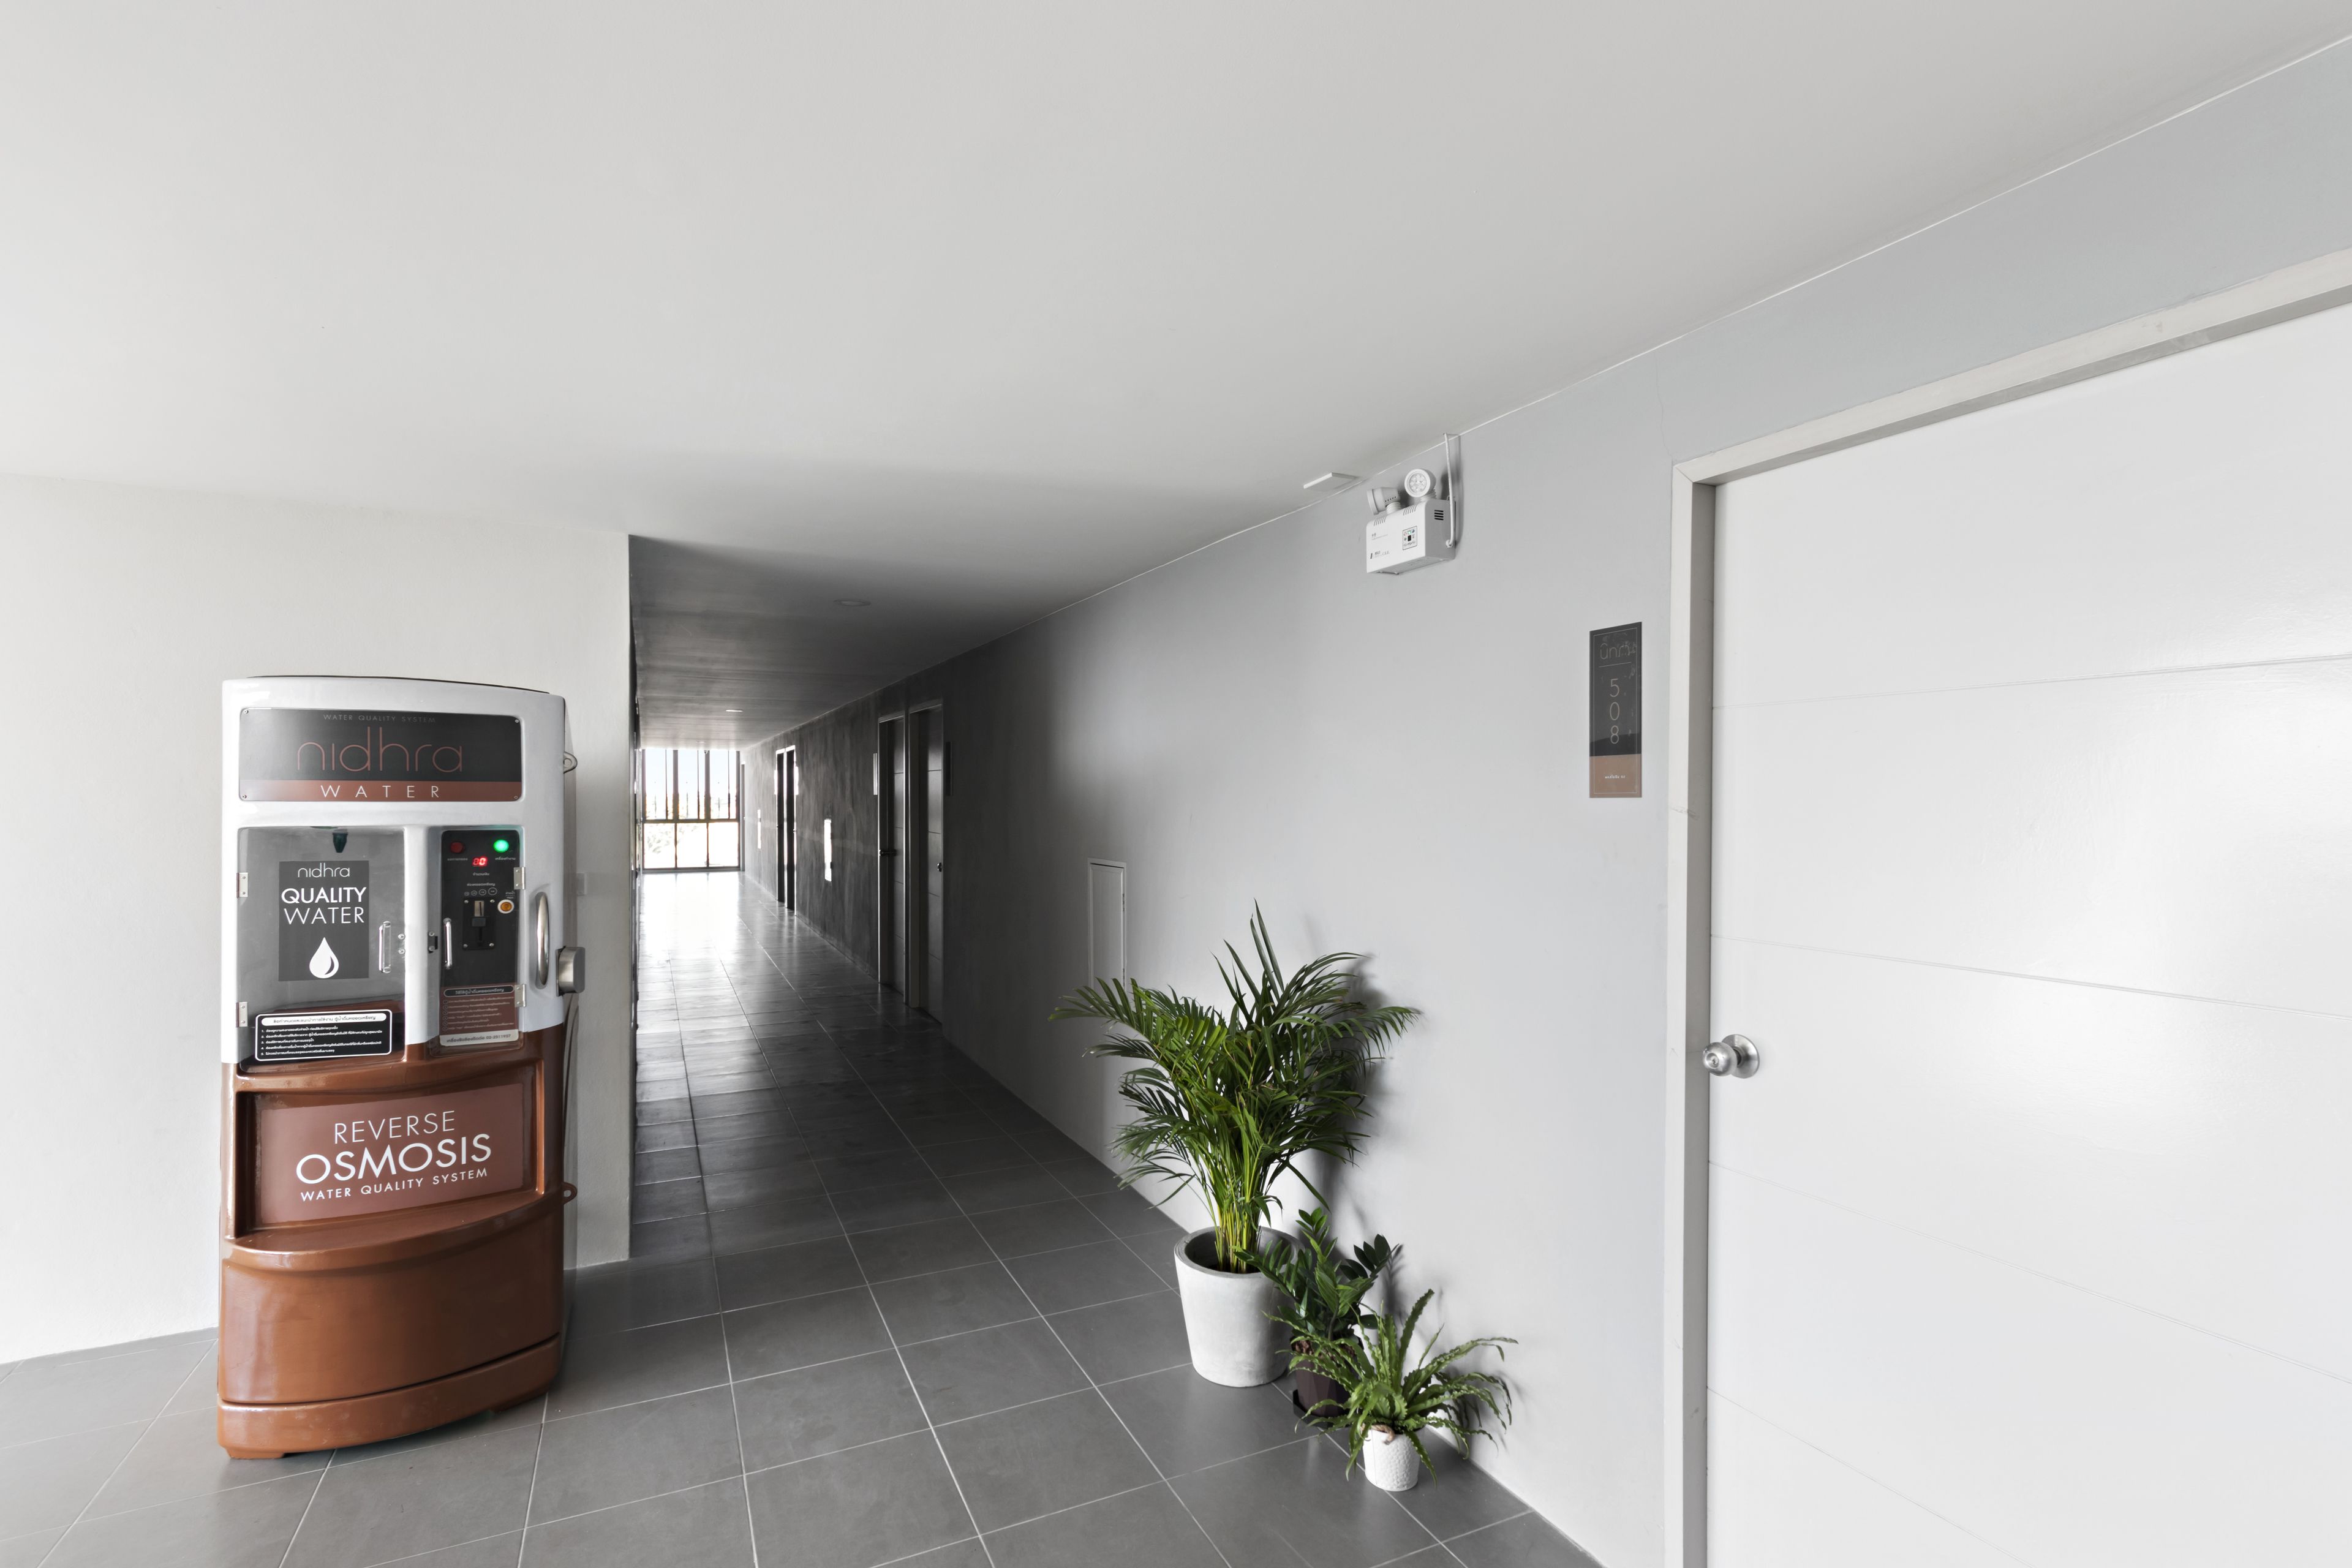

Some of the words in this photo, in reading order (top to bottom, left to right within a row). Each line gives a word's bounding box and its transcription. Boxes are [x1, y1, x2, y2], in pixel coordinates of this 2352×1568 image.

[358, 714, 396, 723] QUALITY
[401, 715, 437, 724] SYSTEM
[1609, 678, 1620, 744] 508
[297, 726, 463, 772] nidhra
[320, 785, 439, 799] WATER
[298, 862, 350, 878] nidhra
[281, 887, 367, 904] QUALITY
[284, 907, 364, 924] WATER
[334, 1110, 455, 1144] REVERSE
[296, 1133, 491, 1184] OSMOSIS
[300, 1187, 352, 1202] WATER
[360, 1177, 424, 1195] QUALITY
[432, 1167, 488, 1185] SYSTEM
